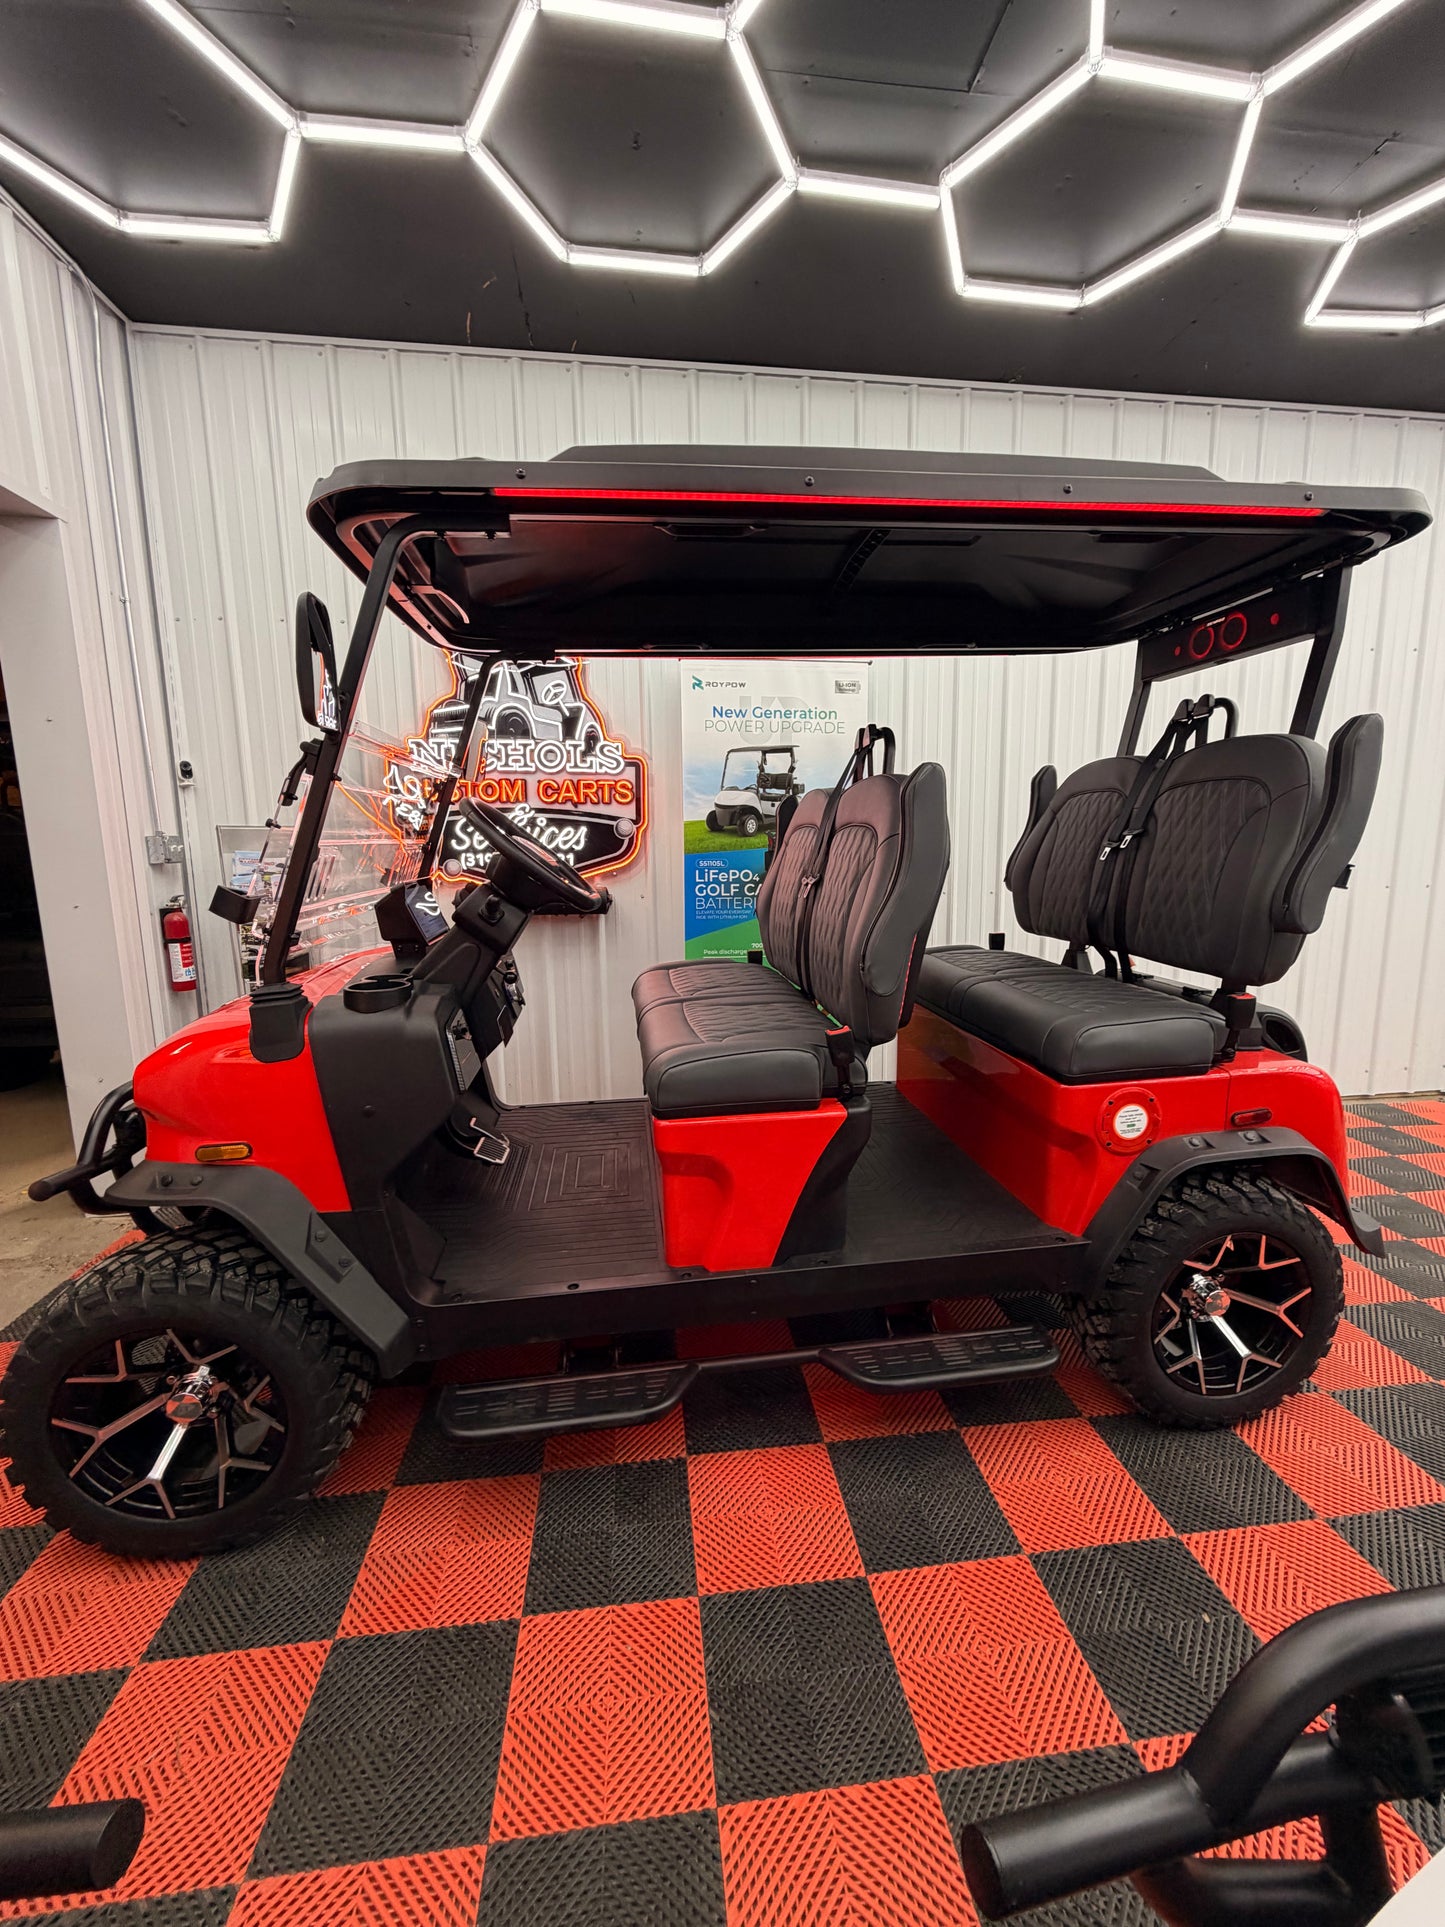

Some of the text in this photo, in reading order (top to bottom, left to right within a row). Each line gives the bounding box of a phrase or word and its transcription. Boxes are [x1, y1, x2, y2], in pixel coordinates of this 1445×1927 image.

[712, 706, 838, 720] New Generation
[704, 720, 845, 734] POWER UPGRADE
[538, 779, 634, 804] CARTS
[450, 816, 588, 850] Seices
[695, 869, 760, 882] LiFePO4
[695, 883, 740, 896] GOLF
[695, 897, 757, 909] BATTERI
